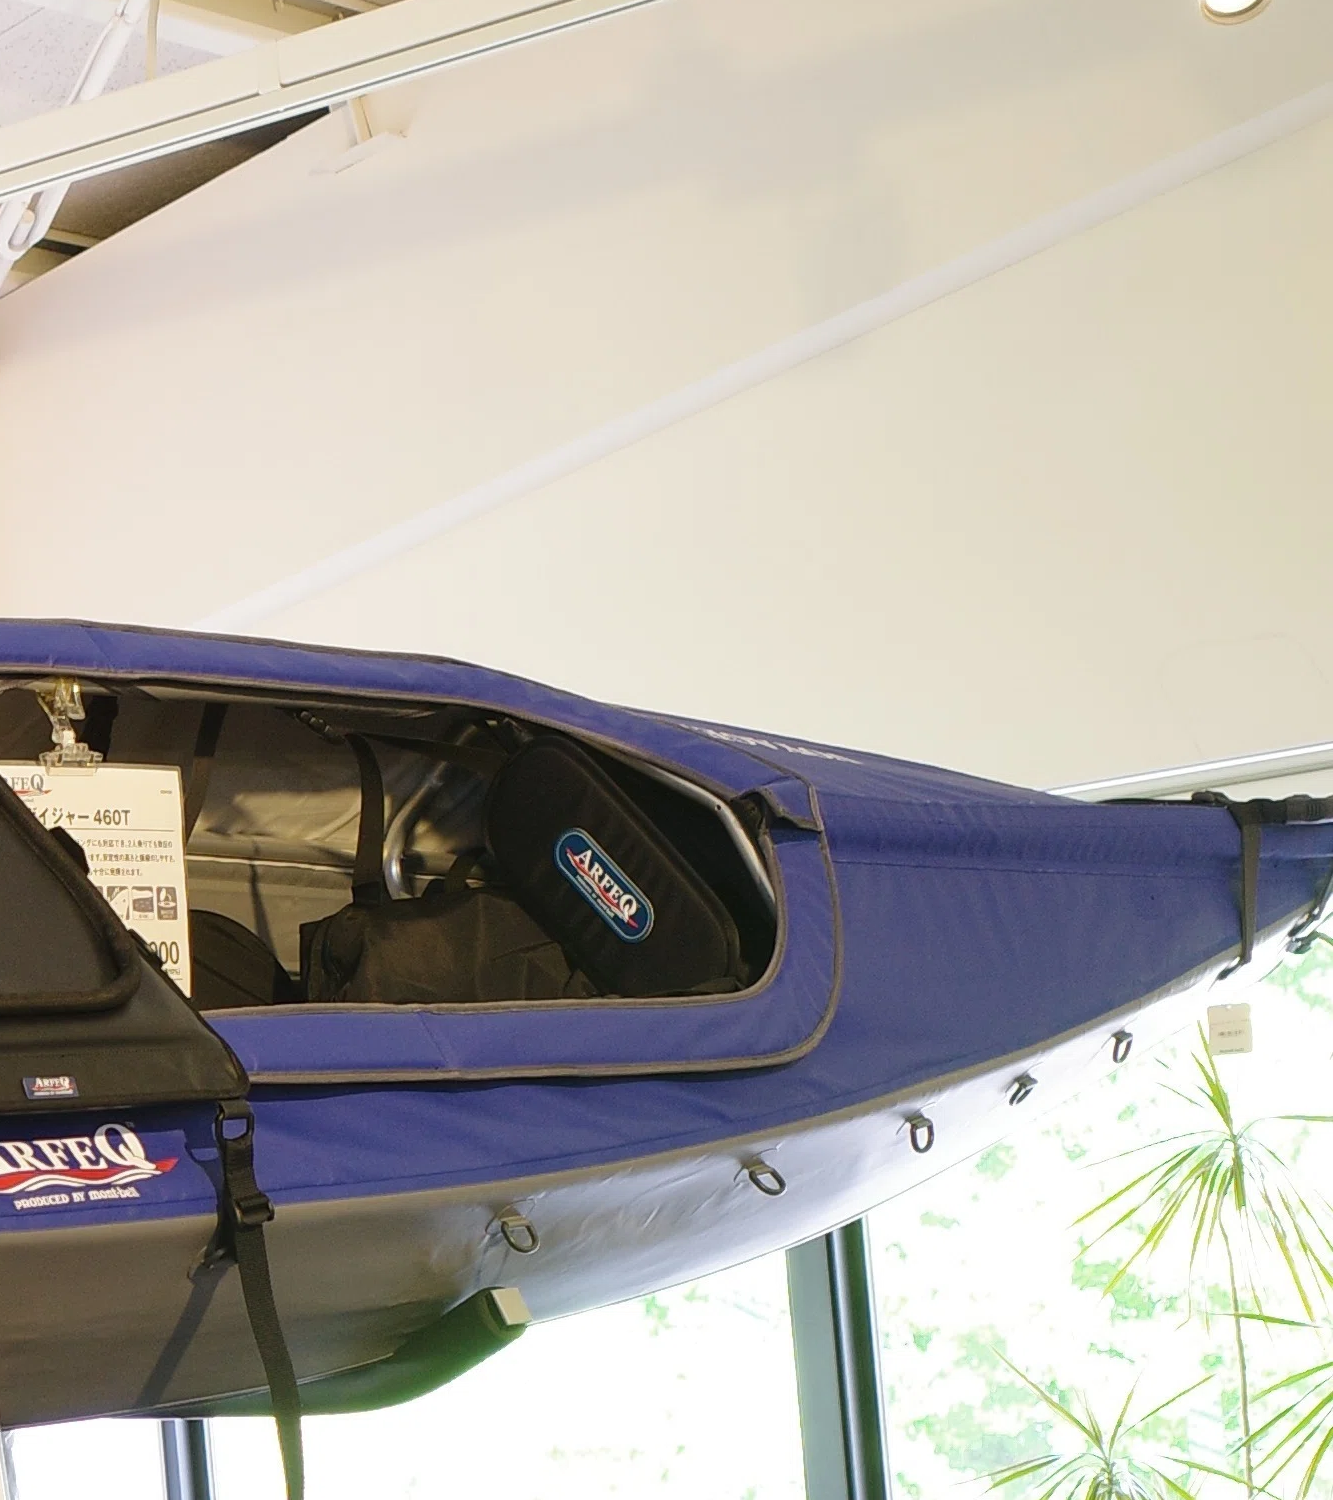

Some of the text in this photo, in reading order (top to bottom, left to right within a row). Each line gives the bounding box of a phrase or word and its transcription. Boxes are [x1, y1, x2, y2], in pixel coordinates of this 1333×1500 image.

[93, 809, 131, 826] 460T
[573, 849, 637, 923] ARFEQ
[34, 1076, 70, 1088] ARFEQ
[14, 1193, 69, 1210] PRODUCED
[73, 1191, 86, 1203] BY
